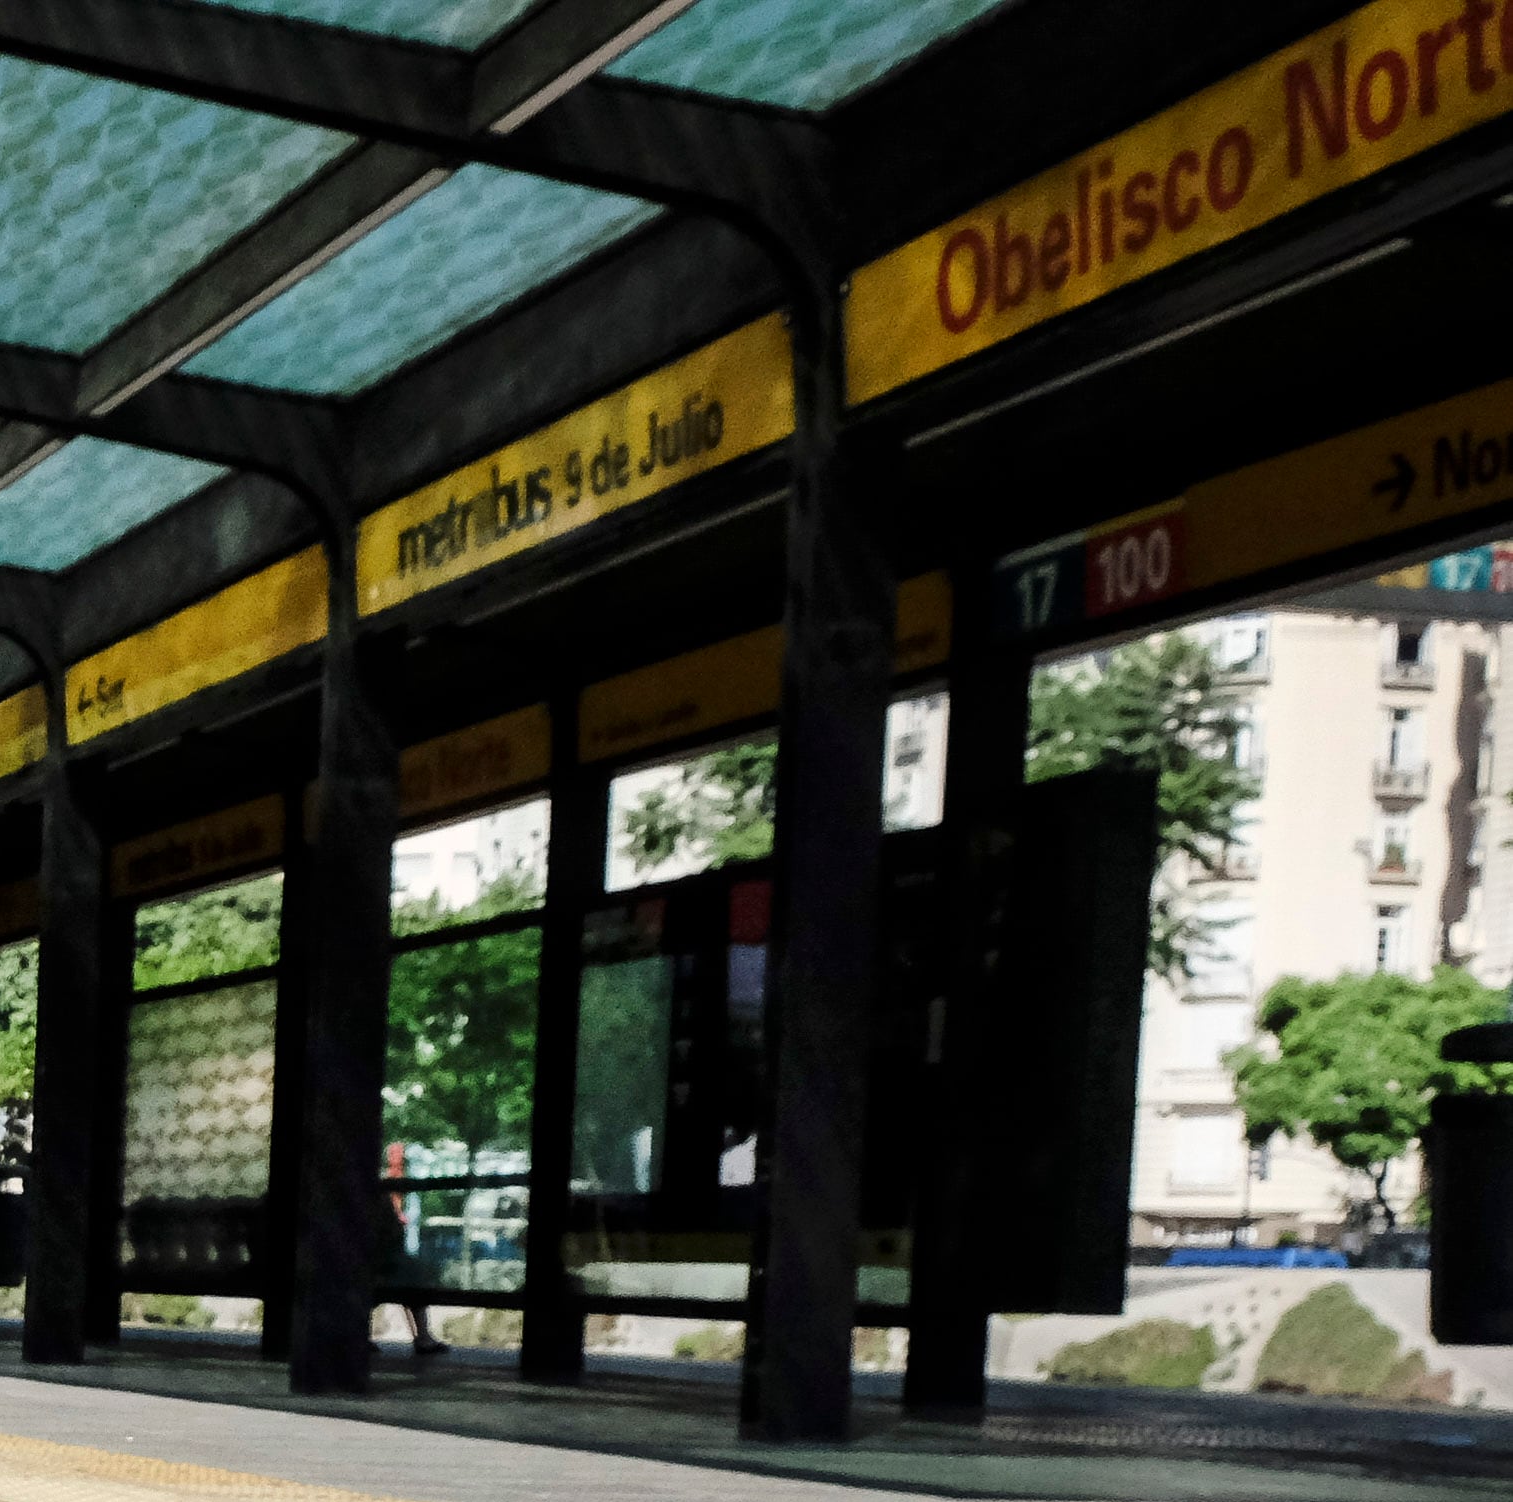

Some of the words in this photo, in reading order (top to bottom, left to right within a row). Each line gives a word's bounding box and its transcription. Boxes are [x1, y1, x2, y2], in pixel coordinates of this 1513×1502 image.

[937, 127, 1254, 335] Obelisco
[564, 448, 583, 508] 9
[589, 434, 630, 497] de
[638, 389, 724, 478] Julio
[1433, 428, 1513, 499] No
[1012, 559, 1063, 633] 17
[1096, 526, 1173, 605] 100
